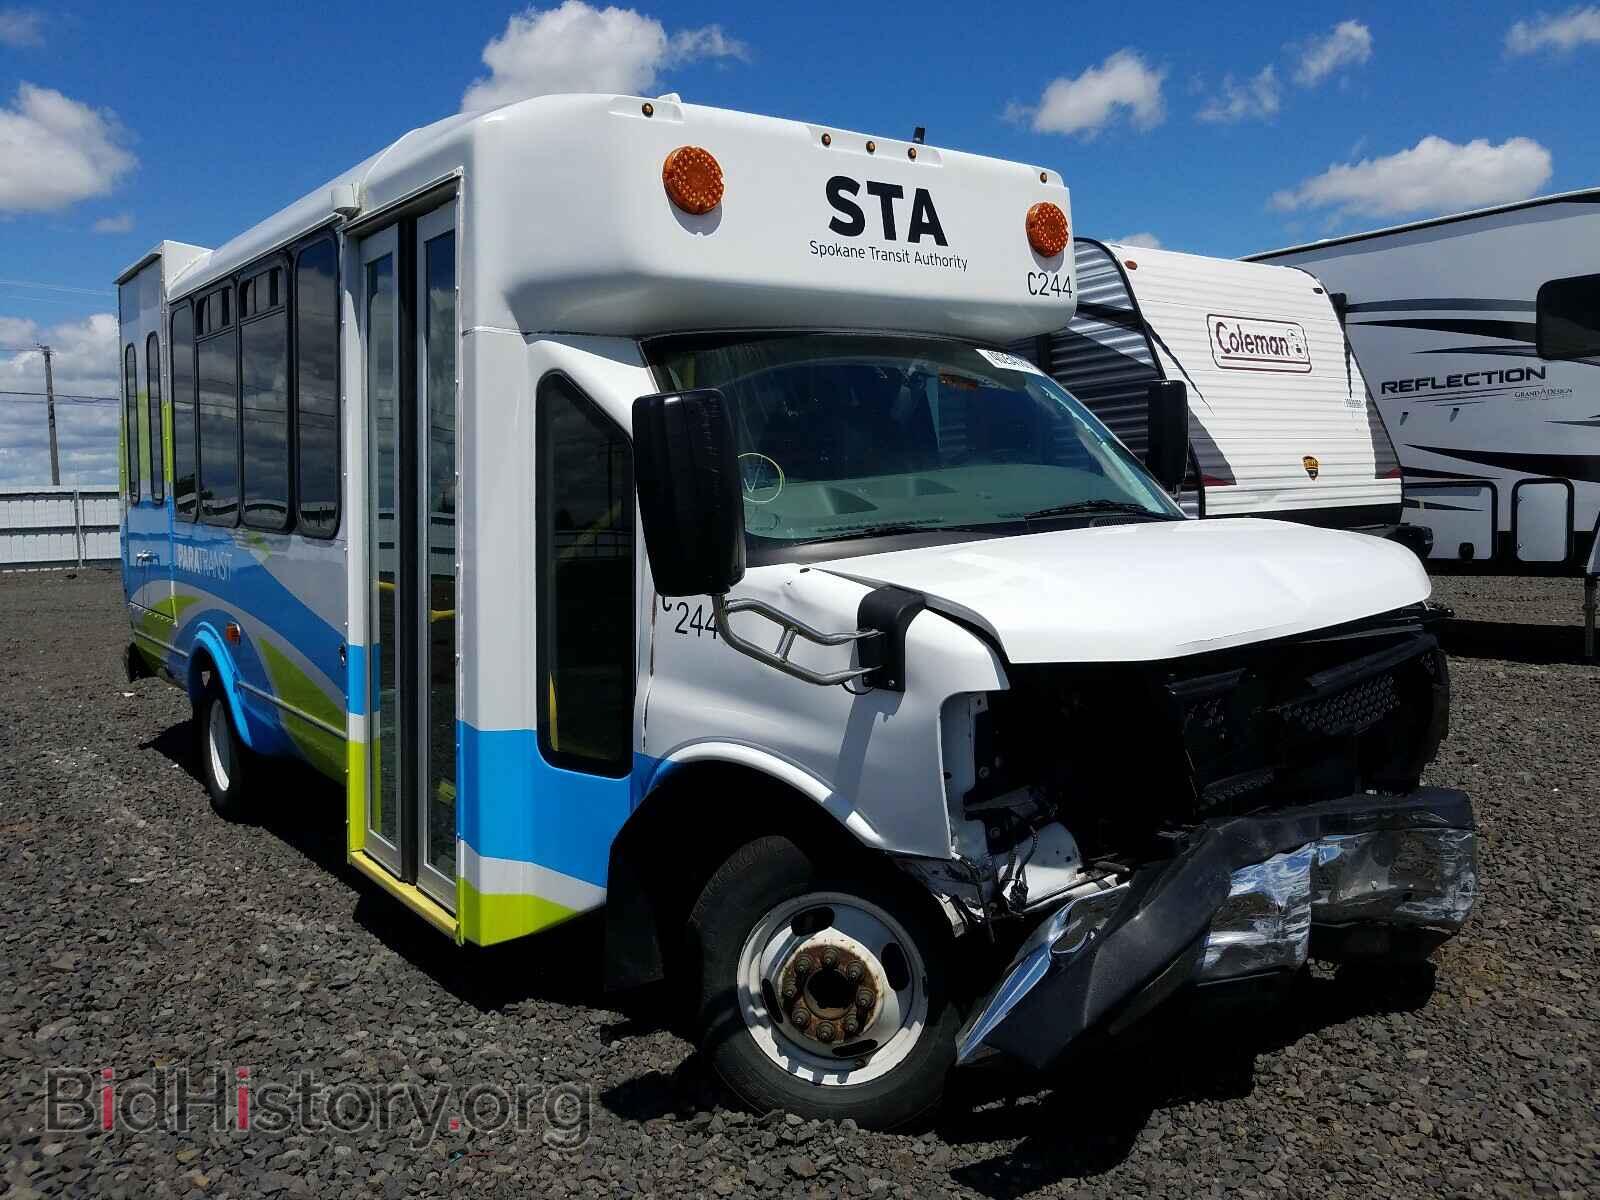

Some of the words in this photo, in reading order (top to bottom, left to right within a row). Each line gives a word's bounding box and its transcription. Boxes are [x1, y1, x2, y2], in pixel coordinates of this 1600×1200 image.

[826, 175, 948, 247] STA
[809, 240, 866, 259] Spokane
[868, 246, 911, 264] Transit
[914, 254, 968, 272] Authority
[1027, 271, 1073, 299] C244
[1216, 321, 1290, 356] Coleman
[1381, 365, 1546, 395] REFLECTION
